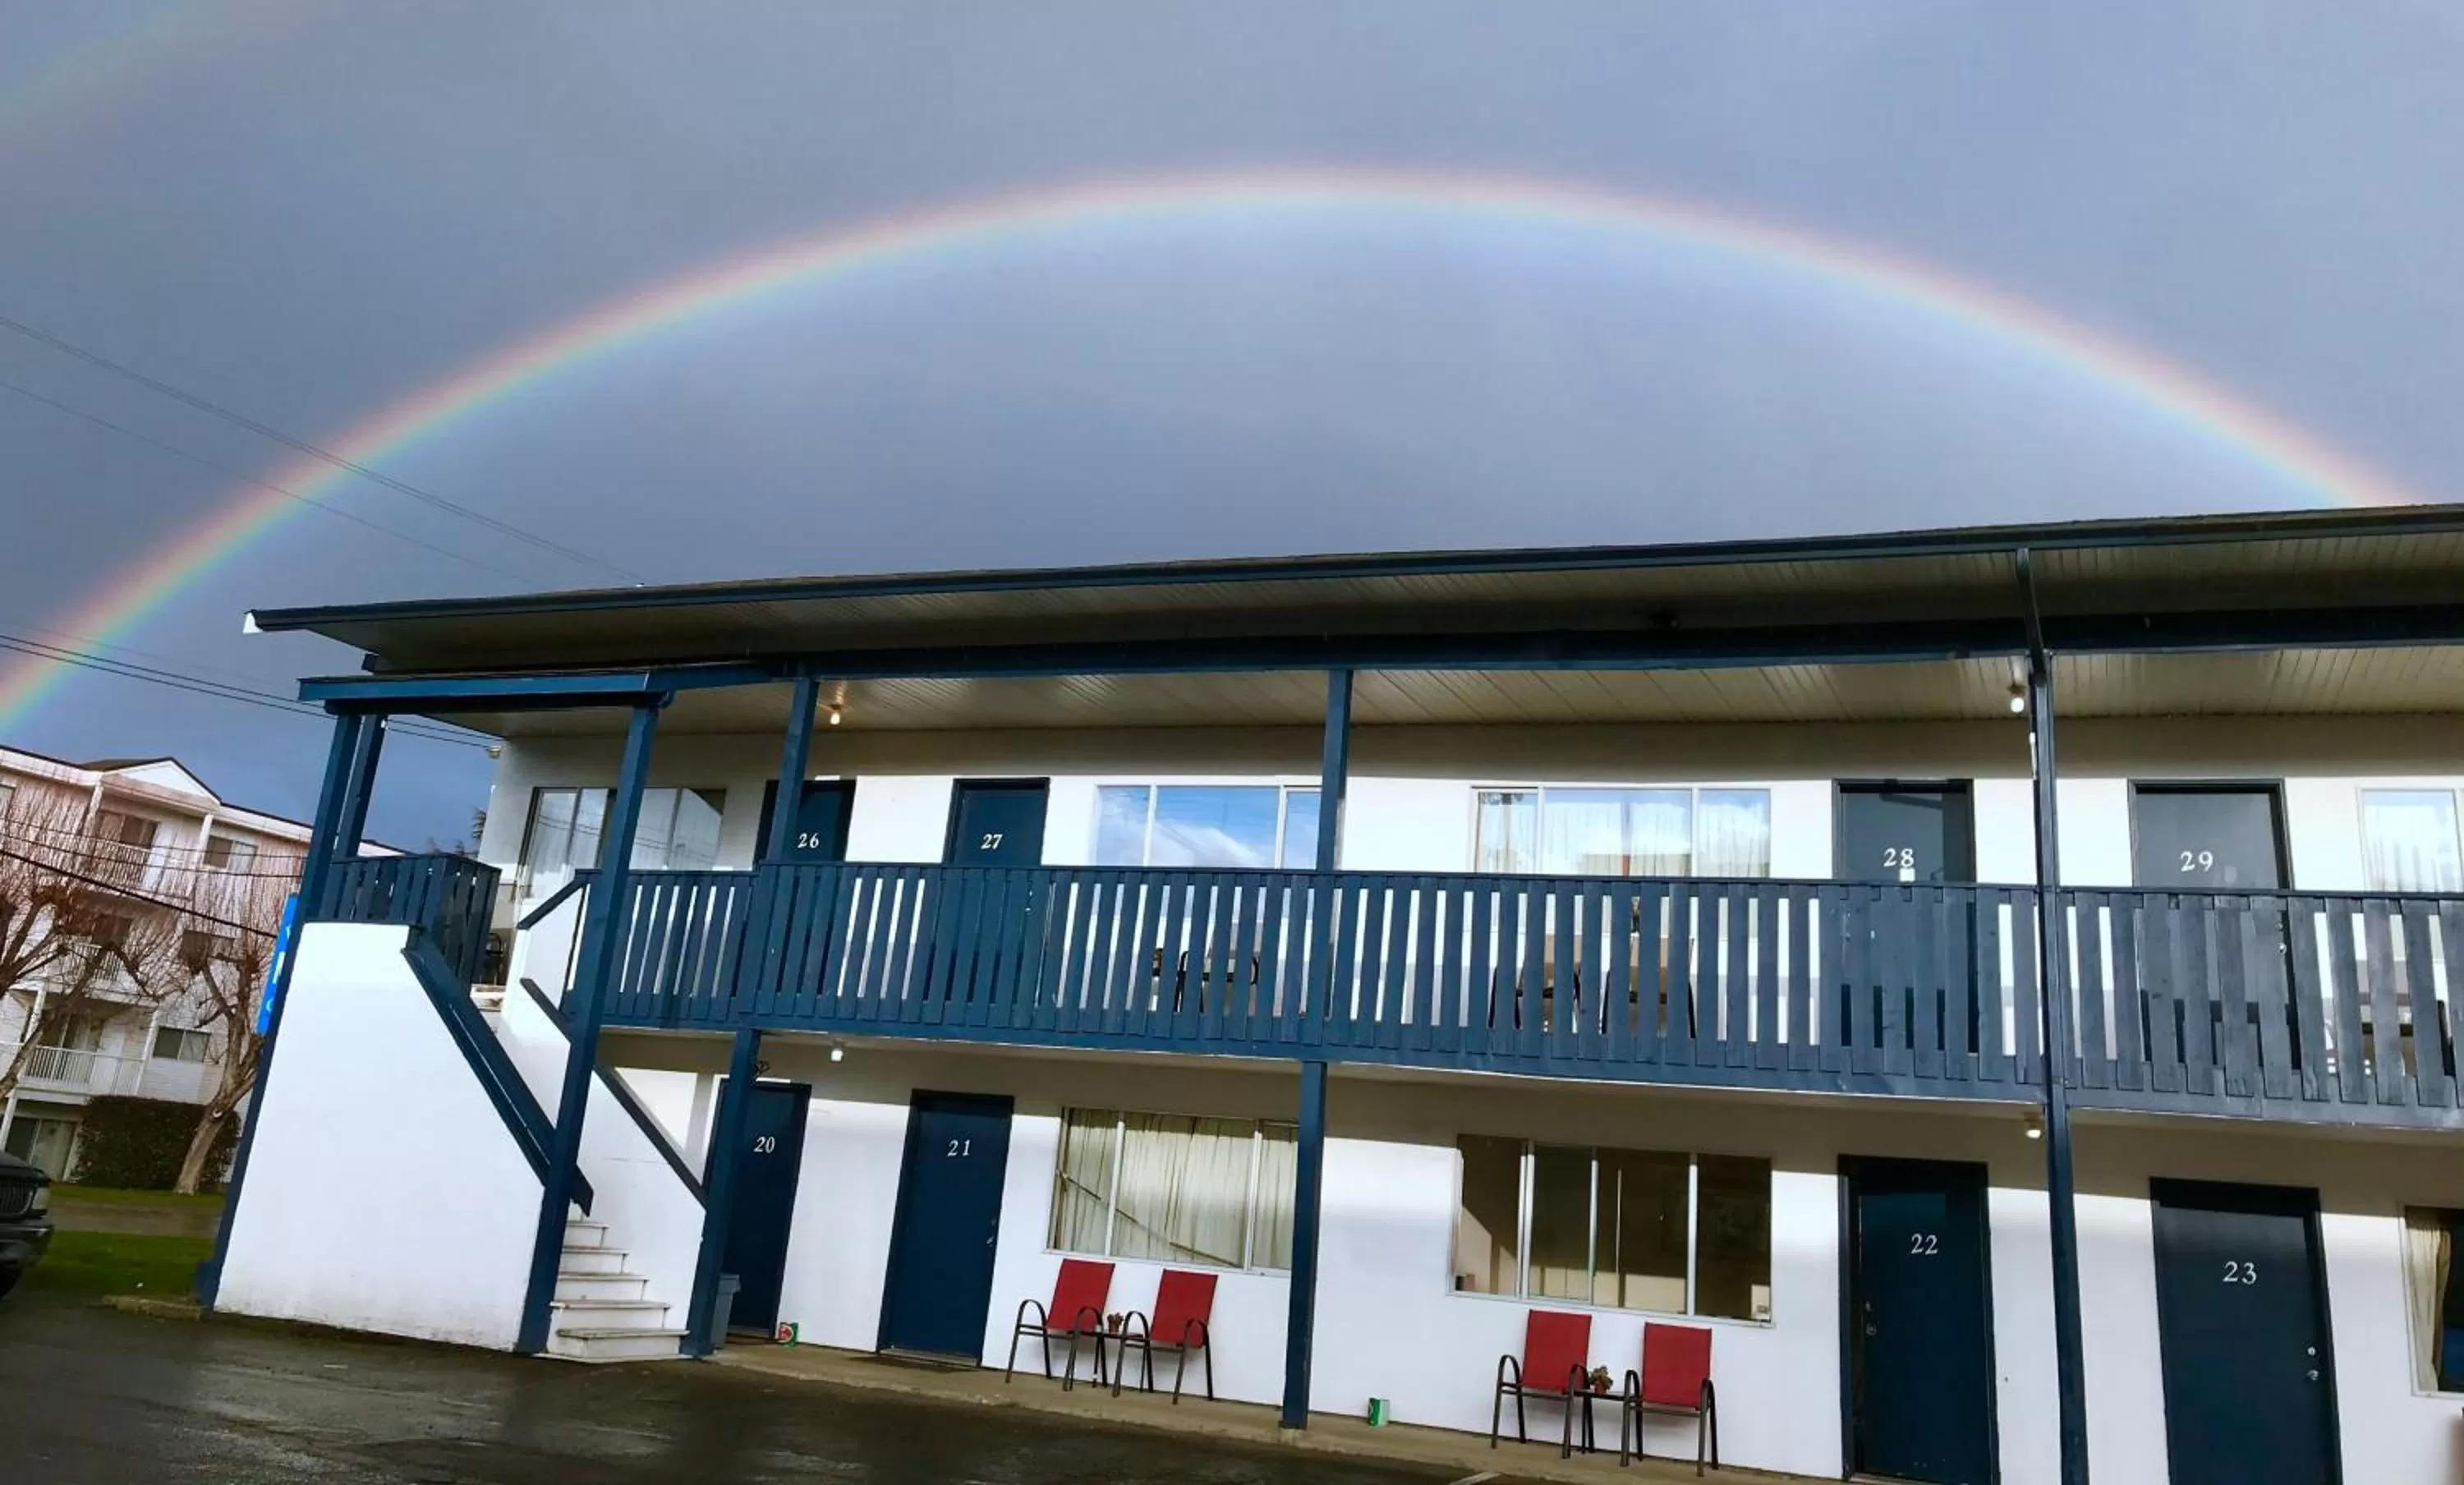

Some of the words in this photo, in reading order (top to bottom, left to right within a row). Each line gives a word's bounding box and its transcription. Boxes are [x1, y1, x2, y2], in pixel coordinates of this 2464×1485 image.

[798, 833, 819, 848] 26
[981, 834, 1003, 849] 27
[1883, 848, 1915, 867] 28
[2181, 851, 2213, 871] 29
[754, 1136, 775, 1153] 20
[947, 1139, 971, 1156] 21
[1911, 1234, 1938, 1254] 22
[2223, 1261, 2257, 1285] 23
